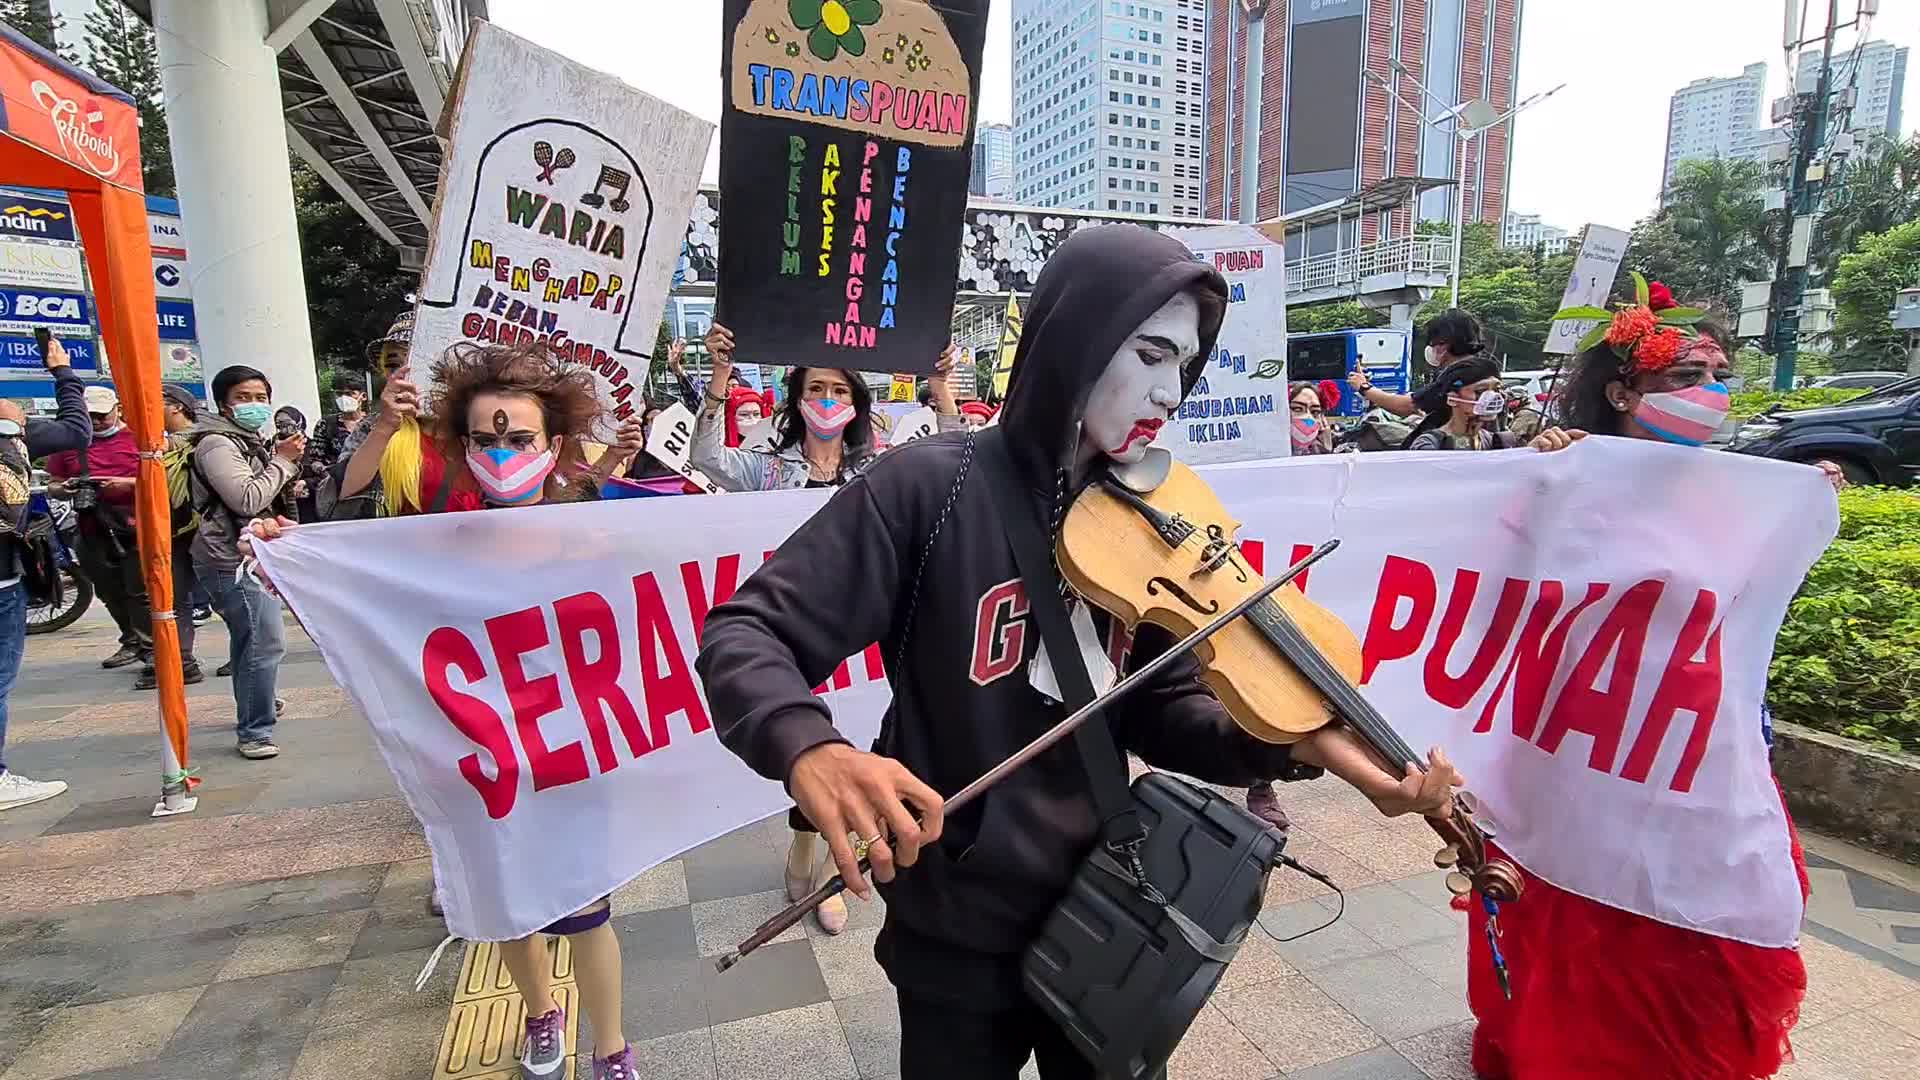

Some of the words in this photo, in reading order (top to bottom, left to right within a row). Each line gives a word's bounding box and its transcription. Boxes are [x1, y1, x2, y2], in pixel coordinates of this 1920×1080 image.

[748, 63, 966, 136] TRANSPUAN
[506, 185, 625, 260] WARIA
[780, 135, 807, 276] BELUM
[817, 143, 841, 277] AKSES
[879, 146, 912, 329] BENCANA
[1214, 250, 1264, 272] PUAN
[470, 239, 626, 315] MENGHADAPI
[16, 295, 80, 319] BCA
[157, 314, 187, 327] LIFE
[472, 283, 559, 334] BEBAN
[8, 343, 41, 356] IBK
[1173, 394, 1274, 420] ERUBAHAN
[1188, 421, 1242, 444] IKLIM
[664, 421, 690, 456] RIP
[1359, 553, 1723, 794] PUNAH
